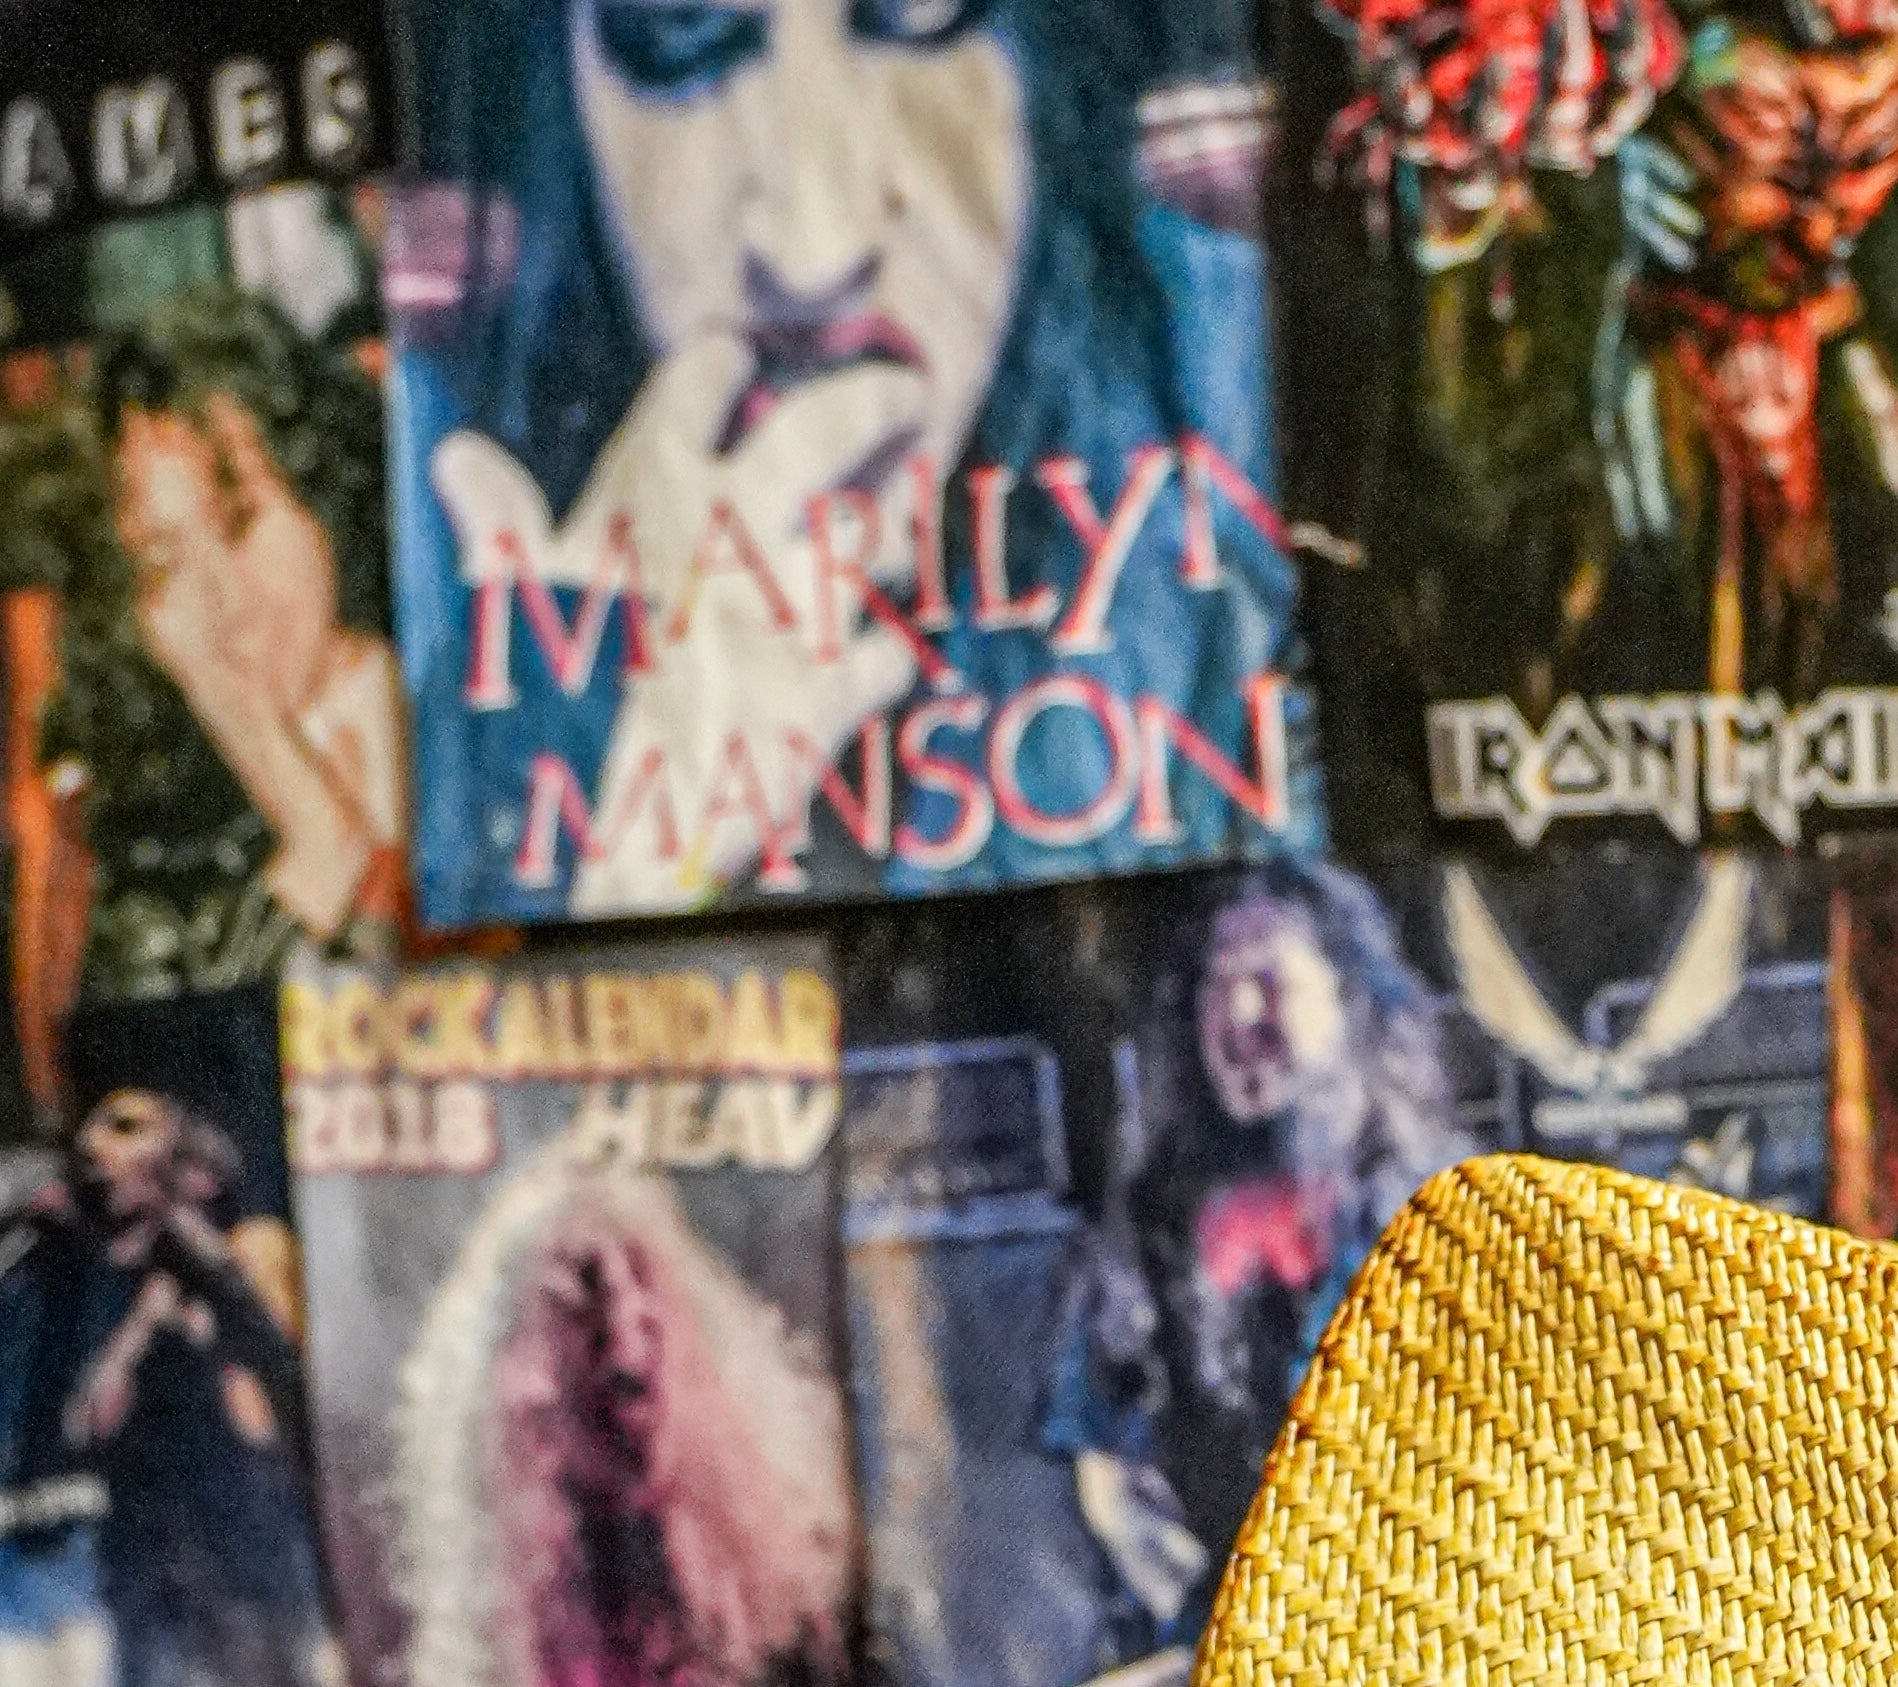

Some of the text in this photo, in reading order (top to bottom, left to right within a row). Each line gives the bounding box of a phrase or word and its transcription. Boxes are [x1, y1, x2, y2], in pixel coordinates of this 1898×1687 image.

[464, 432, 1290, 708] MARILYN
[514, 674, 1290, 892] MANSON
[1428, 692, 1700, 848] IRON
